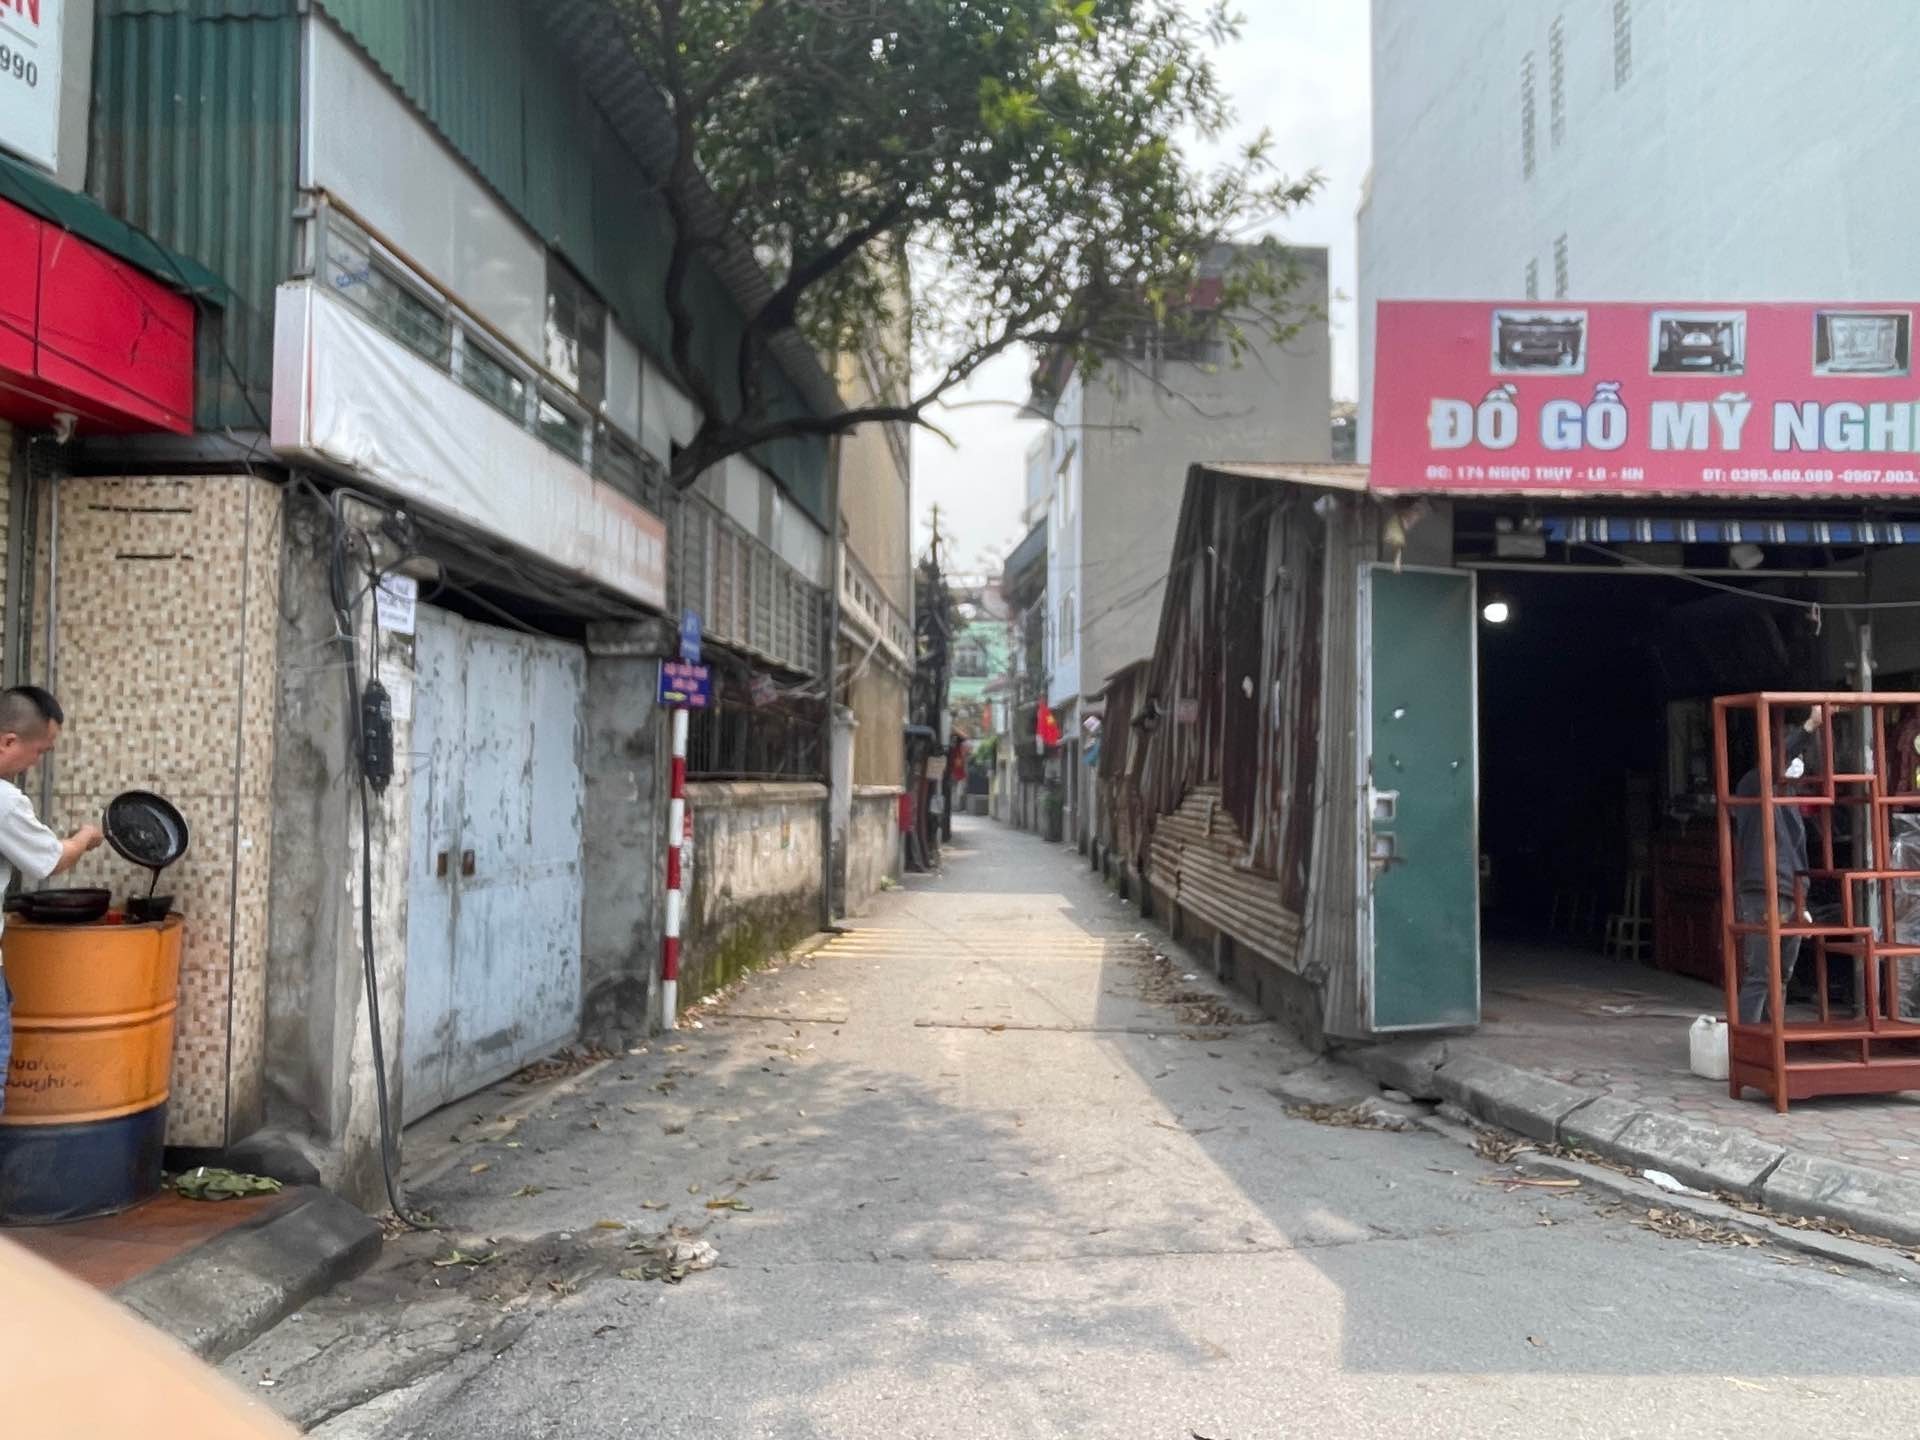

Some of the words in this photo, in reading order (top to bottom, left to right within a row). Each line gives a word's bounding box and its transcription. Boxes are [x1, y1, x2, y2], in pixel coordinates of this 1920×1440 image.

[1427, 382, 1519, 451] ĐỒ
[1540, 379, 1629, 451] GỖ
[1649, 391, 1752, 451] MỸ
[1772, 398, 1920, 452] NGH
